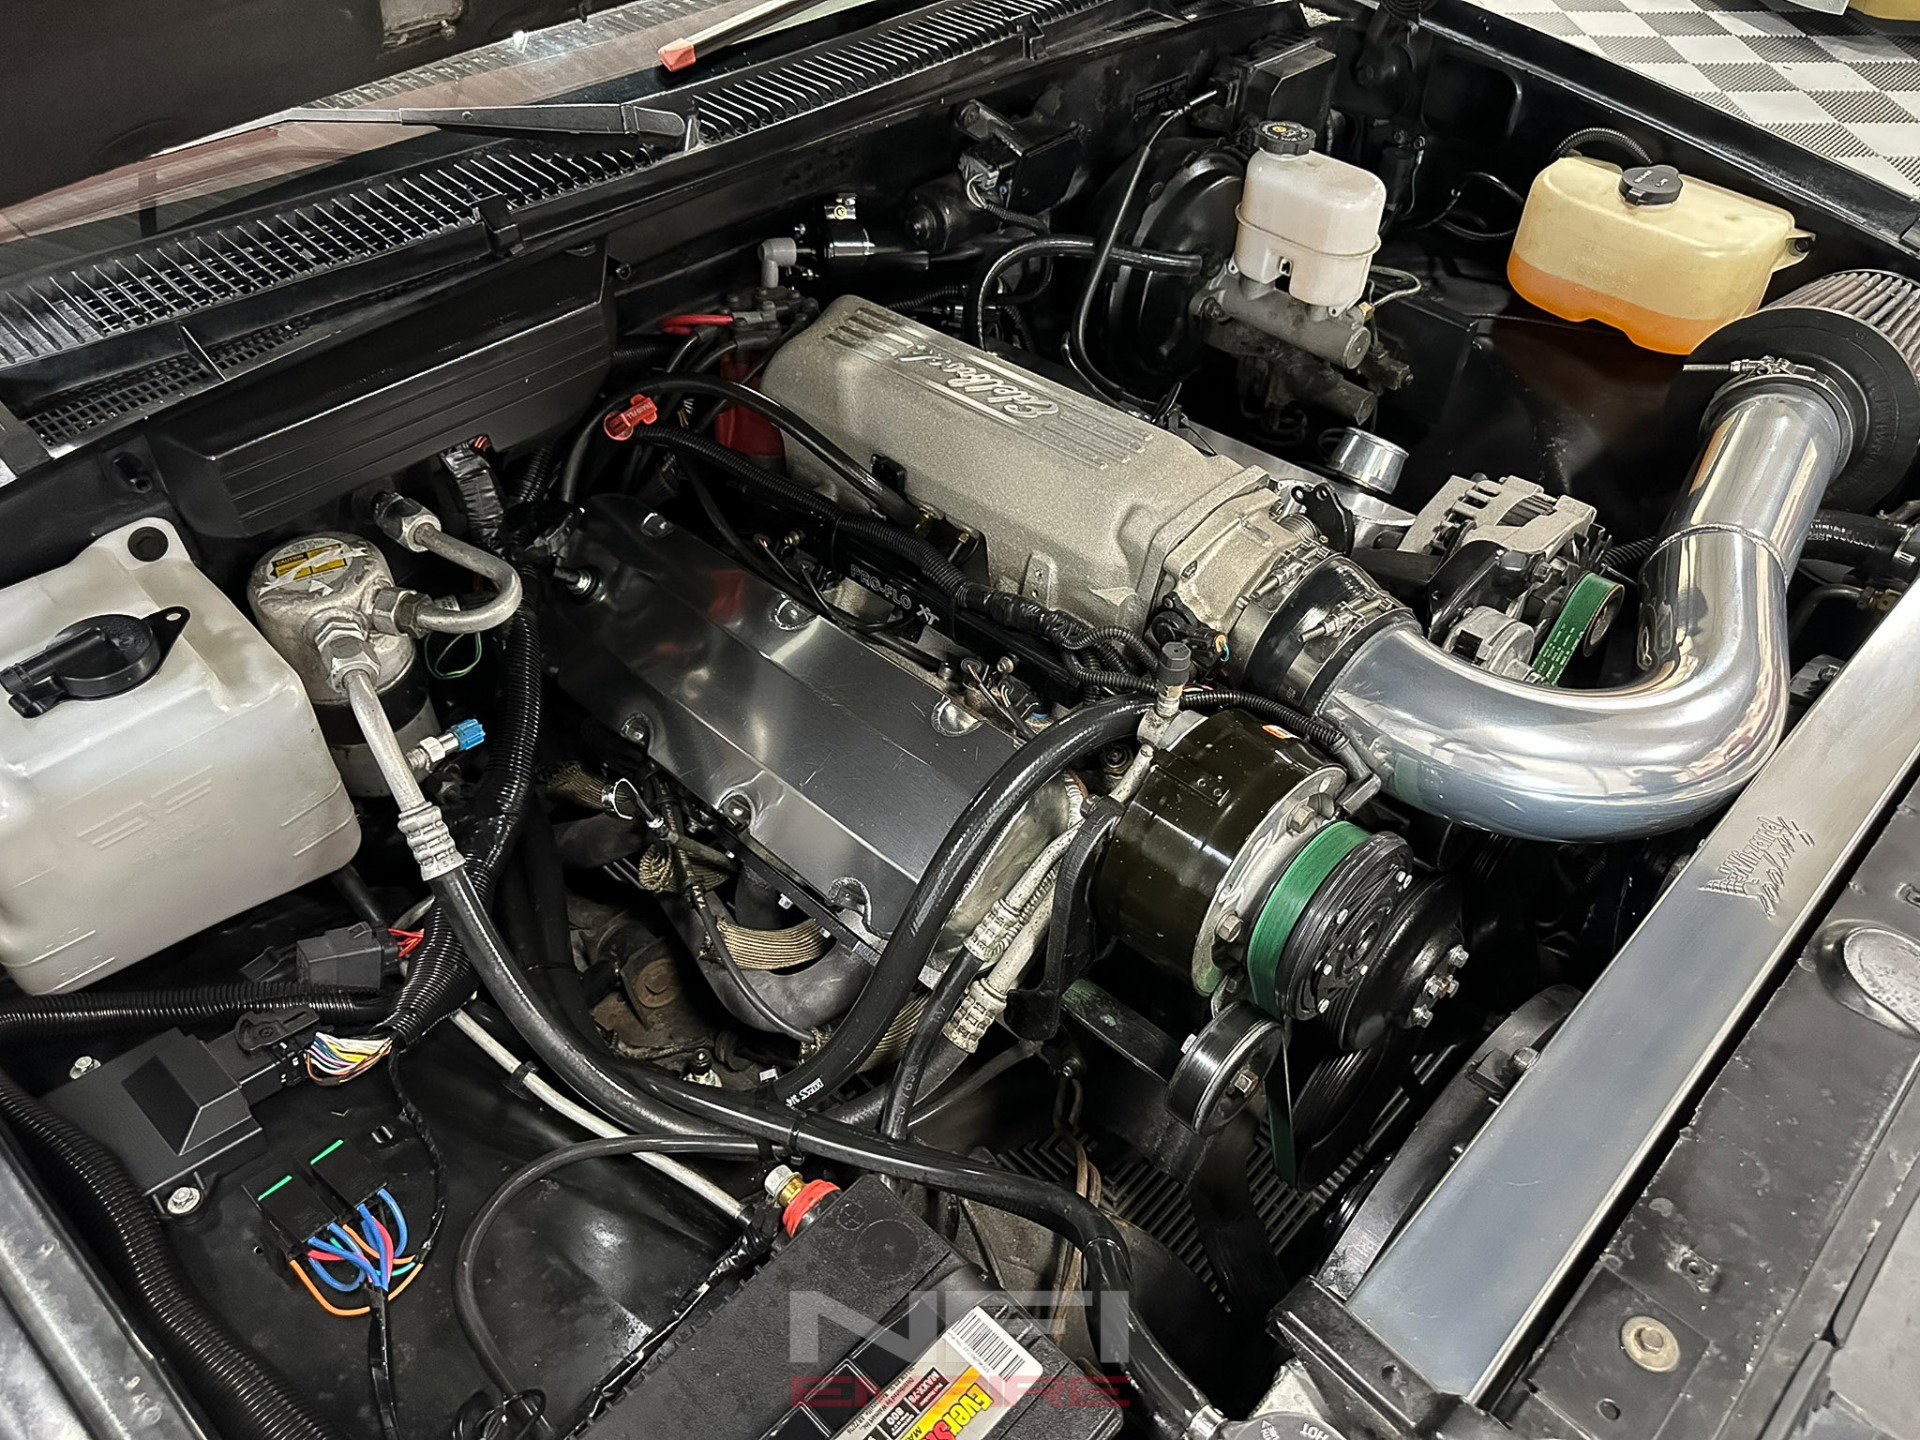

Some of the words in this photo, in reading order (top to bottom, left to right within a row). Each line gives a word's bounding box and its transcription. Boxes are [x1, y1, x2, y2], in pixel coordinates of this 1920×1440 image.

[850, 564, 912, 611] PRO-FLO
[916, 604, 940, 626] XT
[867, 1403, 887, 1423] Walmart
[885, 1406, 904, 1425] 800
